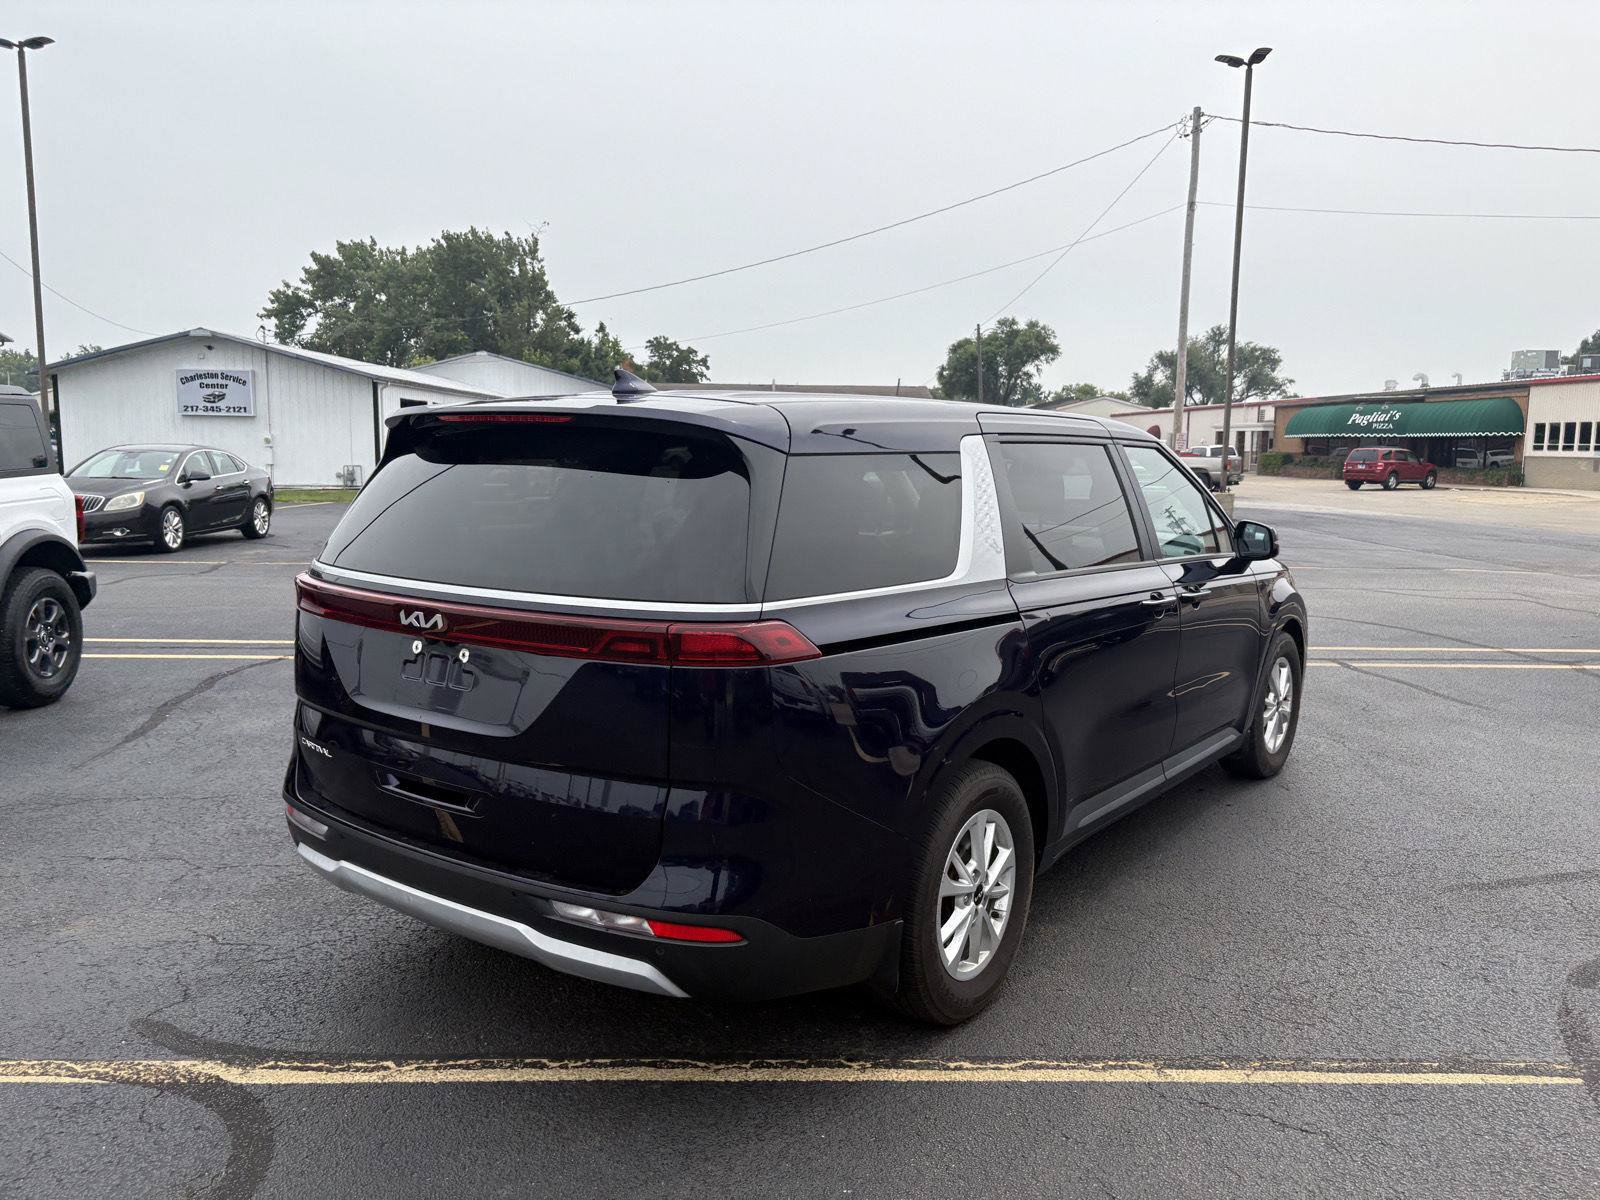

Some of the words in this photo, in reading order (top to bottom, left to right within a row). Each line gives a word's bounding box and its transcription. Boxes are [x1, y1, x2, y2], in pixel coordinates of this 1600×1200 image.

[180, 372, 219, 385] Charleston
[220, 372, 247, 386] Service
[199, 382, 229, 390] Center
[183, 405, 247, 413] 217-345-2121
[1347, 410, 1402, 427] Pagliai's
[1372, 422, 1394, 430] PIZZA
[399, 608, 444, 630] KIA
